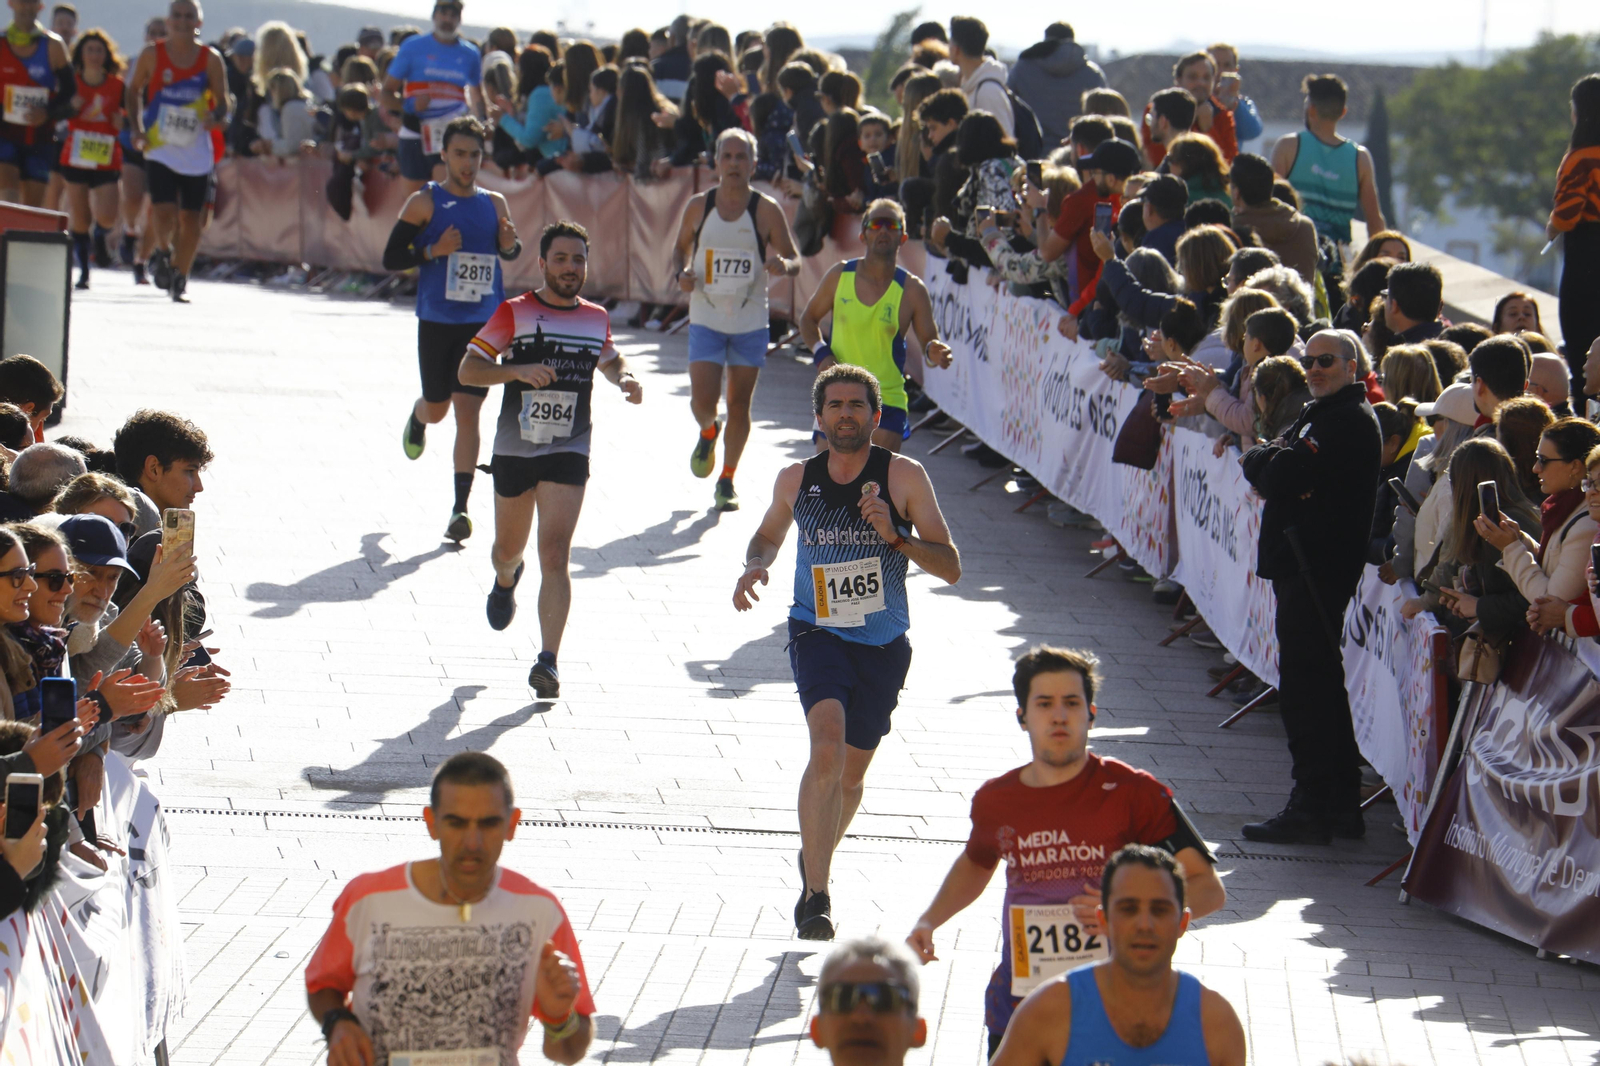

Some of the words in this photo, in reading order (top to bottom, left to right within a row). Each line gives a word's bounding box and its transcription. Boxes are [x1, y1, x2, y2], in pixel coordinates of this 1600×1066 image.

[459, 263, 492, 282] 2878
[714, 258, 751, 274] 1779
[530, 402, 572, 422] 2964
[831, 564, 858, 573] IMDECO
[827, 572, 880, 600] 1465
[1017, 829, 1070, 850] MEDIA
[1443, 813, 1487, 858] Instituto
[1020, 840, 1105, 868] MARATÓN
[1033, 908, 1070, 917] IMDECO
[1027, 923, 1101, 953] 2182
